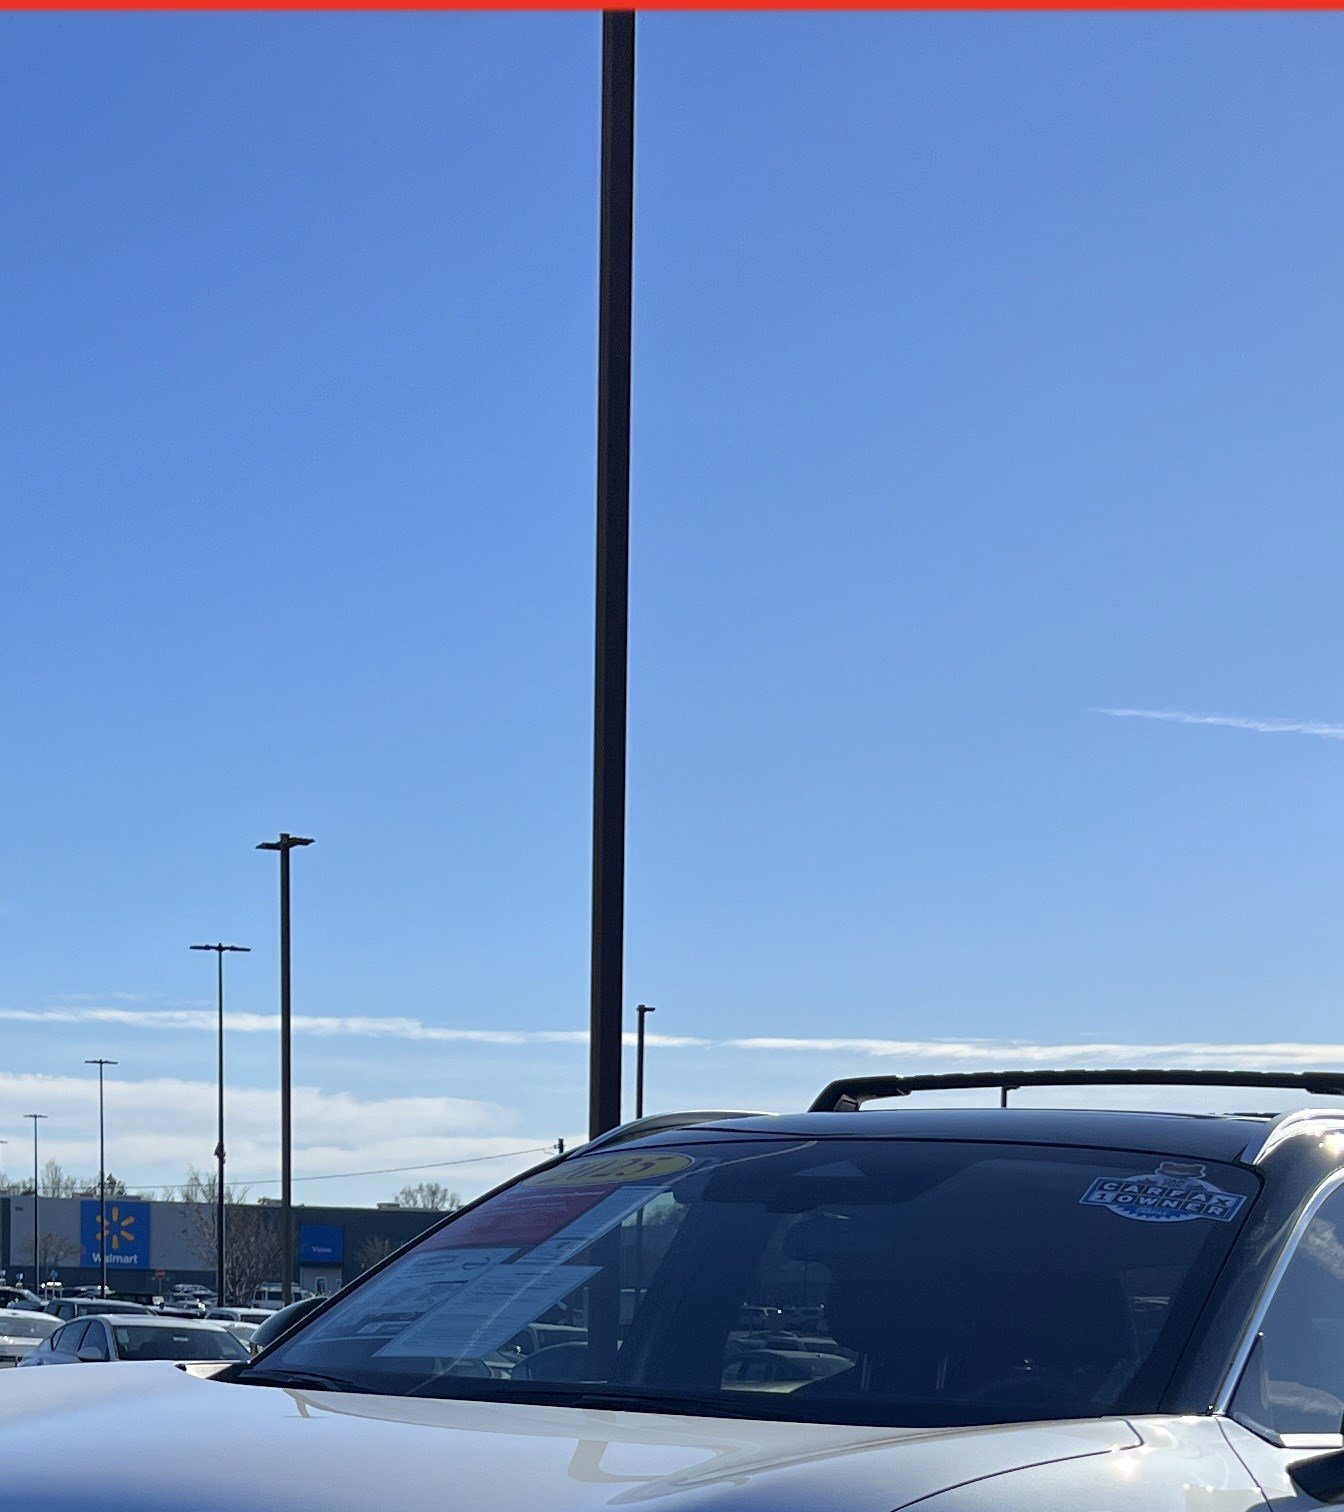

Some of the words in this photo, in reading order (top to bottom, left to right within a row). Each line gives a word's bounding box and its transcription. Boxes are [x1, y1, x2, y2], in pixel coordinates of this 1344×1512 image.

[1102, 1182, 1233, 1208] CARFAX
[1116, 1194, 1224, 1215] OWNER
[92, 1252, 138, 1264] Walmart
